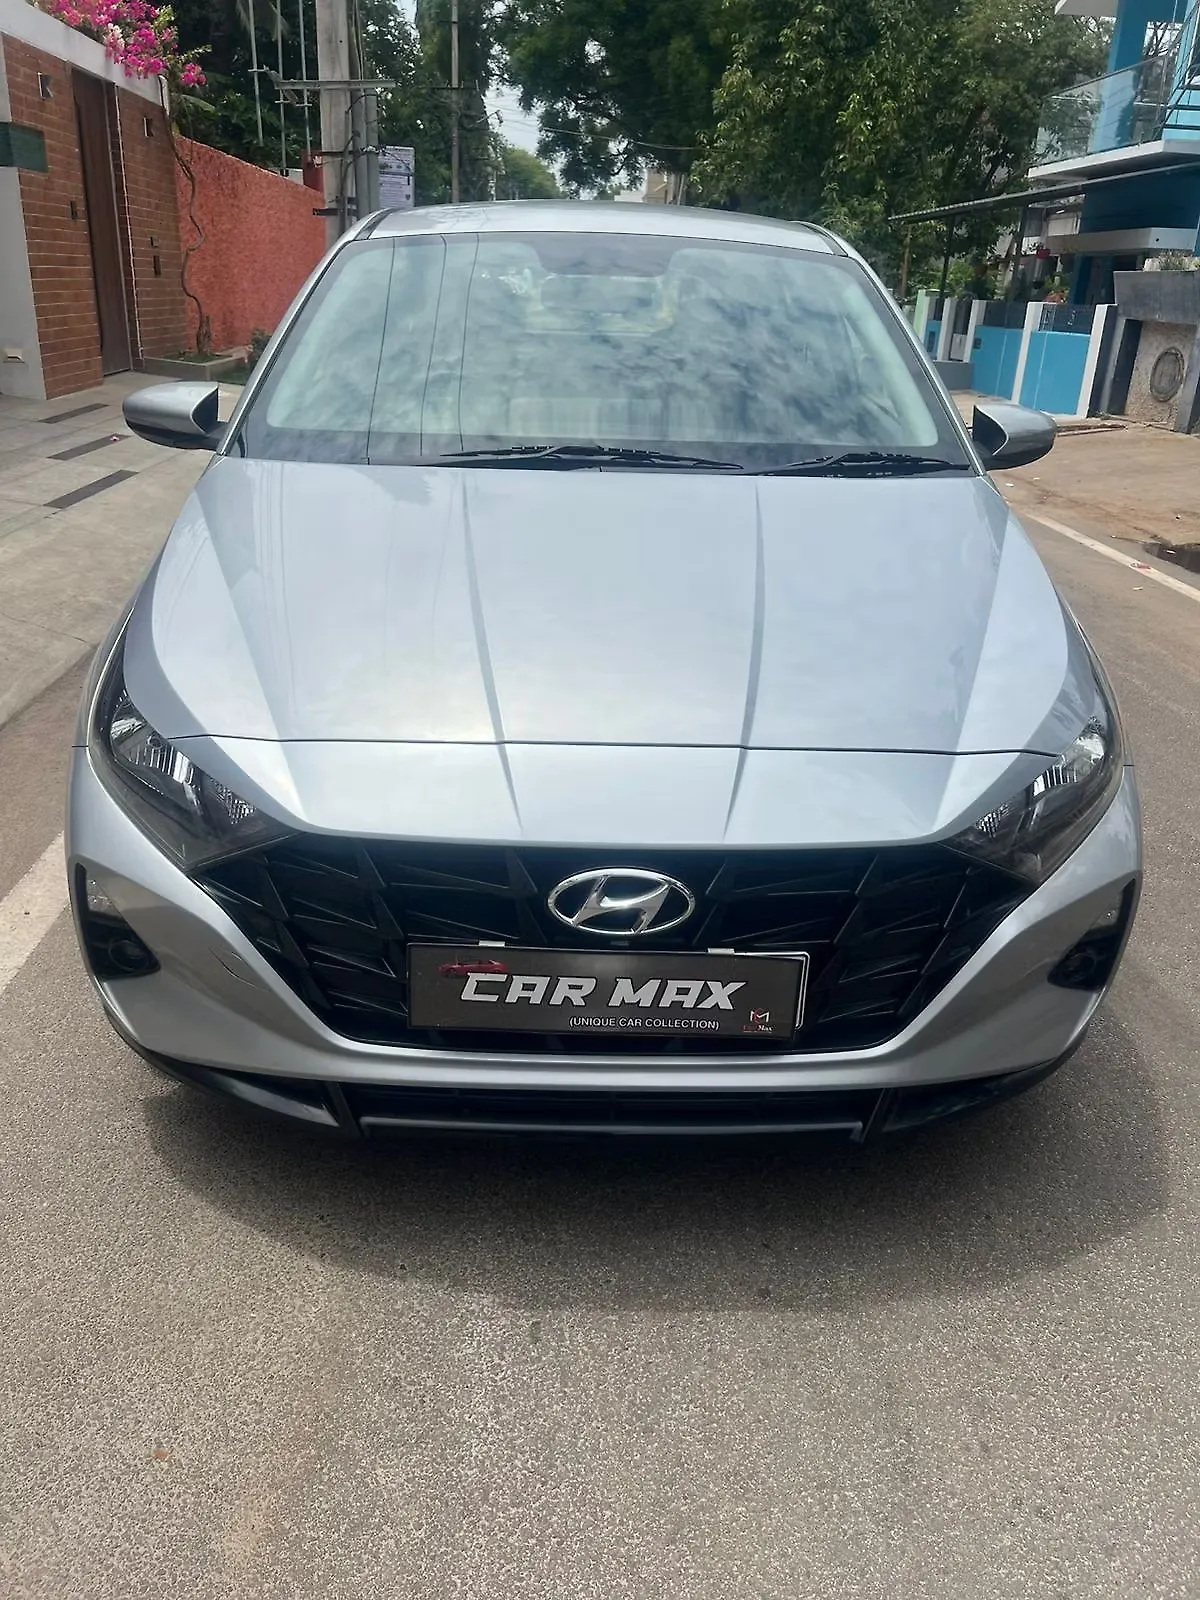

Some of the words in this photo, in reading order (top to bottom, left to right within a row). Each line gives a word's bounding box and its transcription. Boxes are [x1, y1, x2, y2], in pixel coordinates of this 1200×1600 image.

[460, 971, 597, 1006] CAR
[607, 977, 747, 1010] MAX
[569, 1017, 616, 1027] (UNIQUE
[618, 1018, 642, 1027] CAR
[644, 1018, 720, 1030] COLLECTION)
